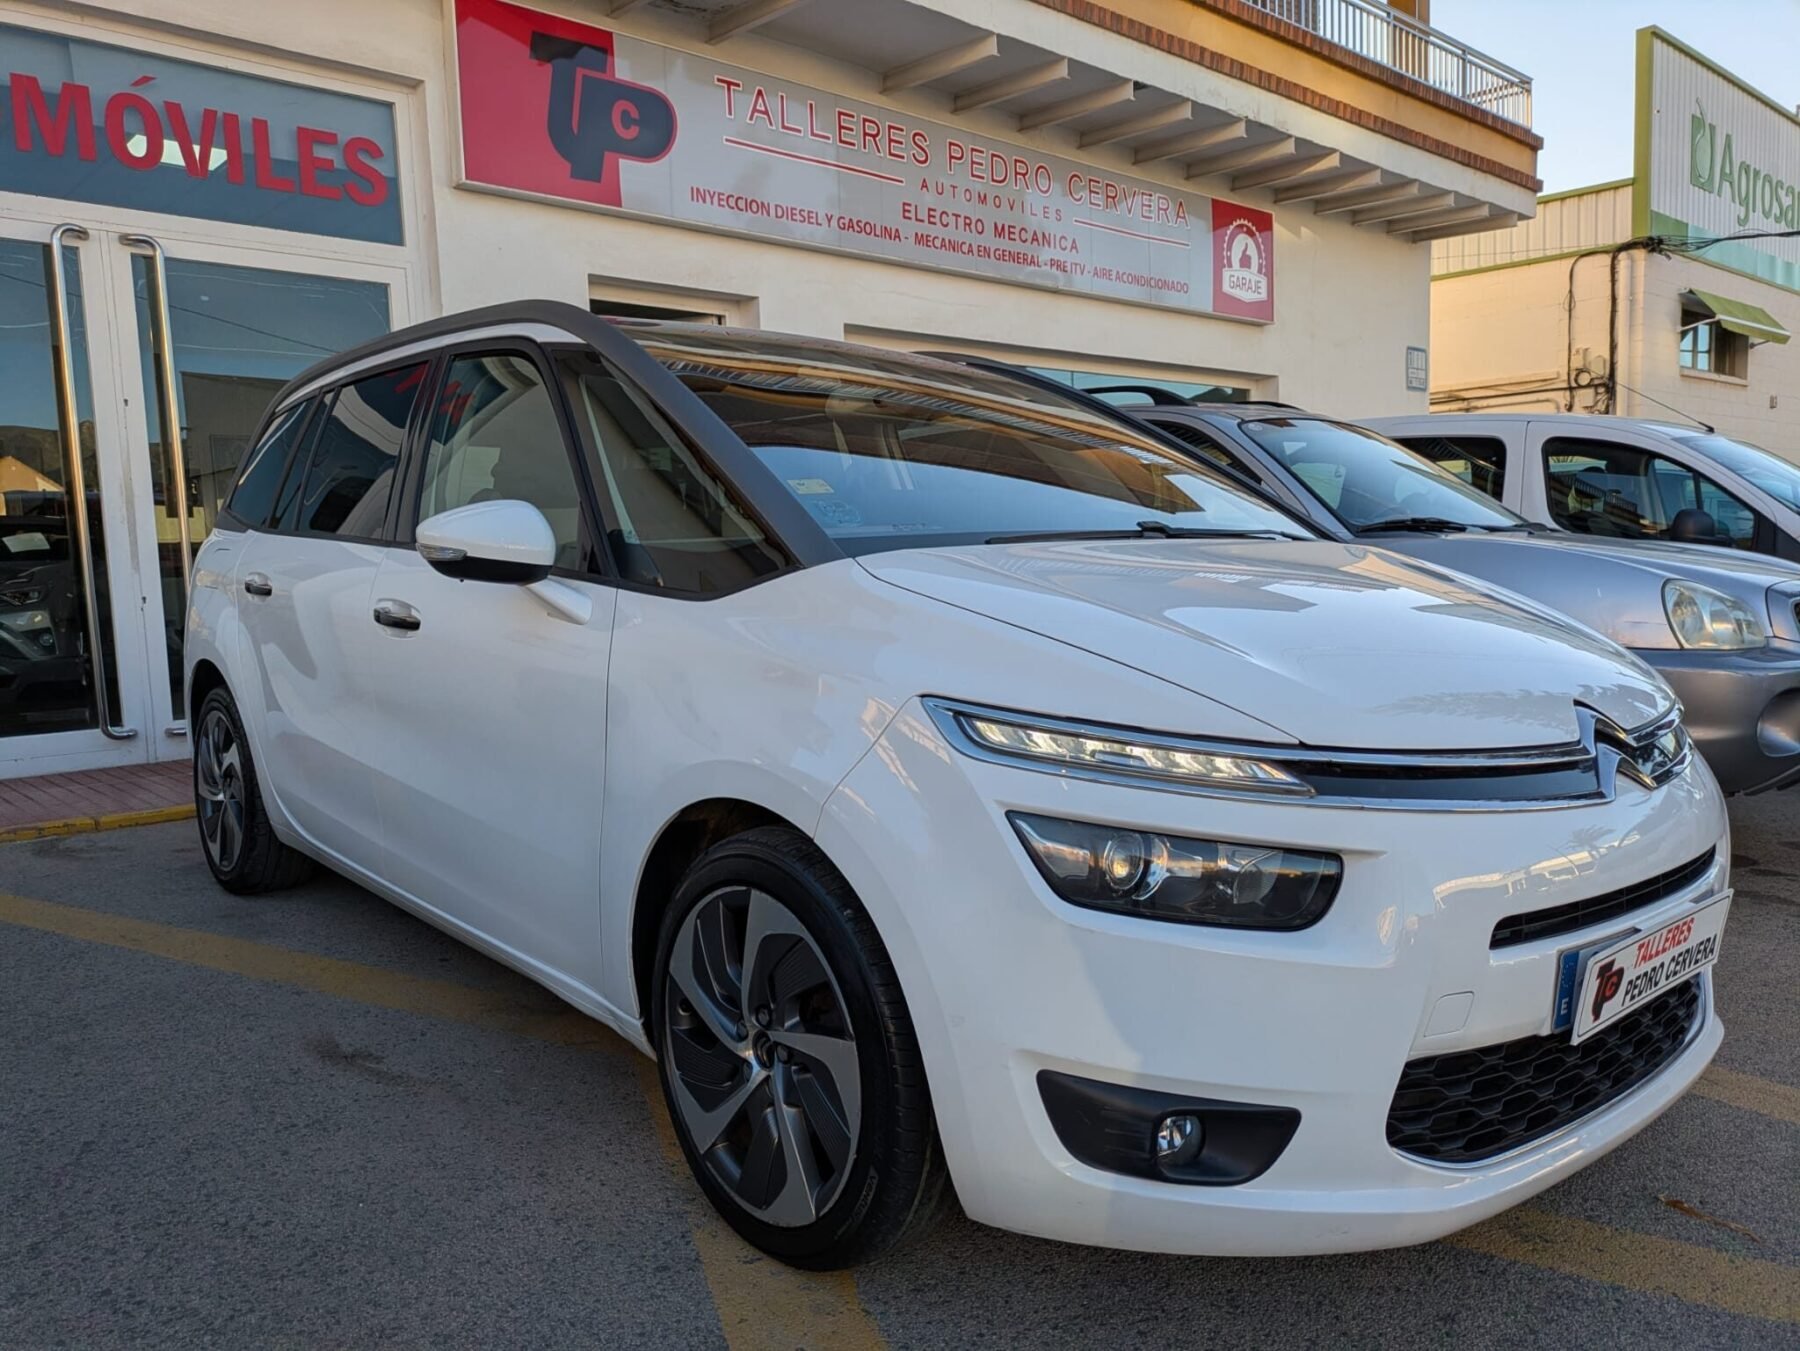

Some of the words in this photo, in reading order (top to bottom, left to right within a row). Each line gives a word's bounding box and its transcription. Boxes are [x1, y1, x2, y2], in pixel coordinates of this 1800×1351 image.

[9, 72, 390, 206] MÓVILES
[714, 75, 931, 167] TALLERES
[946, 139, 1053, 197] PEDRO
[1067, 171, 1191, 229] CERVERA
[920, 178, 1062, 222] AUTOMOVILES
[1717, 133, 1800, 230] Agrosa
[690, 186, 771, 217] INYECCION
[774, 204, 822, 226] DIESEL
[825, 213, 836, 228] Y
[837, 216, 901, 243] GASOLINA
[914, 232, 975, 257] MECANICA
[977, 245, 991, 259] EN
[993, 248, 1042, 268] GENERAL
[1050, 258, 1068, 272] PRE
[1070, 262, 1086, 276] ITV
[1093, 266, 1113, 281] AIRE
[1115, 270, 1189, 293] ACONDICIONADO
[902, 202, 985, 235] ELECTRO
[993, 222, 1079, 254] MECANICA
[1228, 274, 1262, 295] GARAJE
[1621, 961, 1665, 1007] PEDRO
[1665, 933, 1718, 982] CERVERA
[1633, 917, 1695, 969] TALLERES
[1560, 997, 1569, 1014] E
